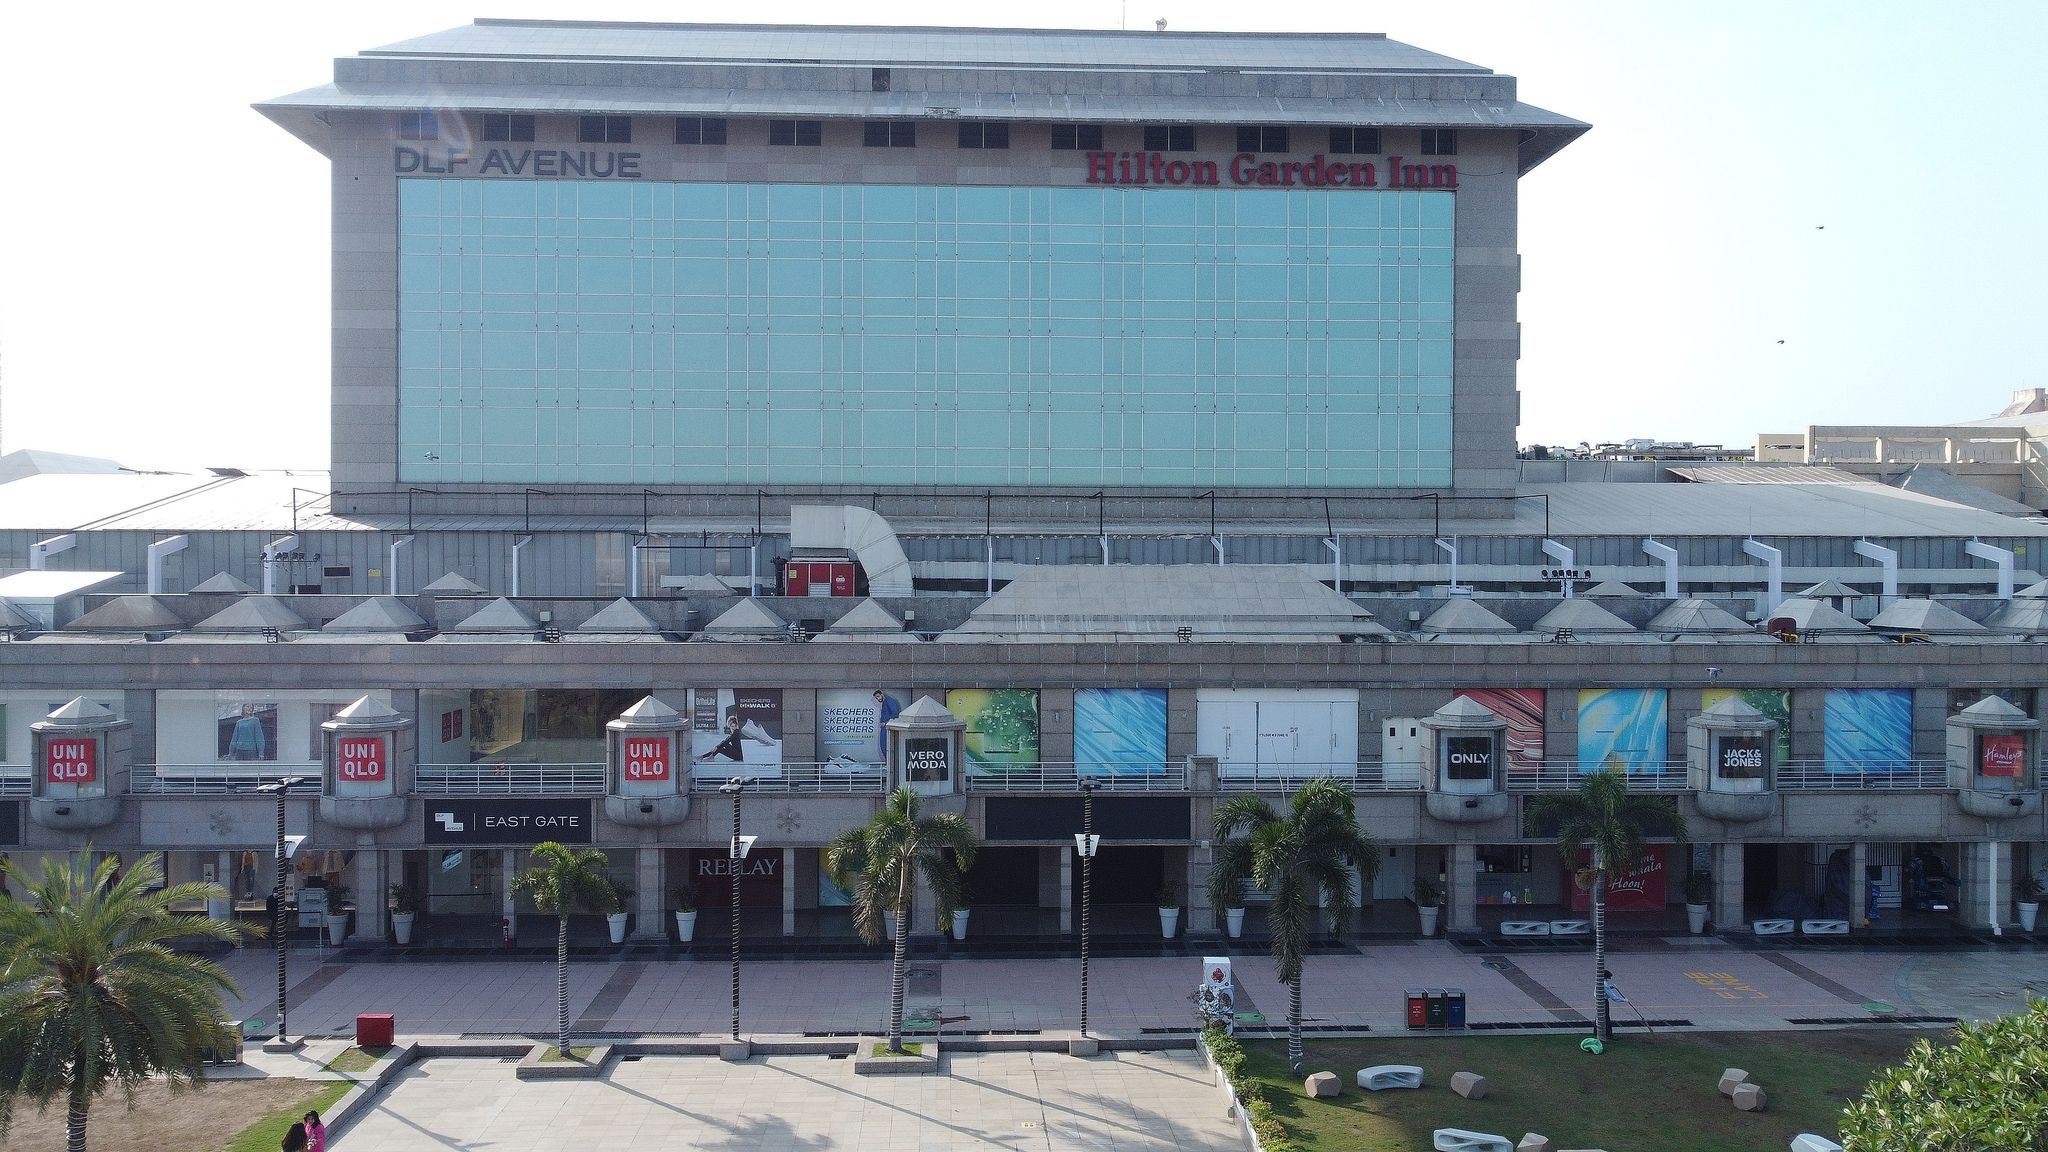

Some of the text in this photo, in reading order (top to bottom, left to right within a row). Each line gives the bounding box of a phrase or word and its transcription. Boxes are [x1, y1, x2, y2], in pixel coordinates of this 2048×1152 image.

[395, 147, 641, 177] DLF AVENUE
[1086, 151, 1459, 189] Hilton Garden Inn
[824, 708, 875, 716] SKECHERS
[824, 717, 875, 725] SKECHERS
[824, 725, 875, 733] SKECHERS
[53, 745, 84, 759] UNI
[345, 744, 375, 758] UNI
[630, 743, 660, 758] UNI
[909, 751, 944, 760] VERO
[1724, 749, 1761, 758] JACK&
[1451, 753, 1491, 763] ONLY
[1724, 758, 1761, 767] JONES
[345, 761, 378, 778] QLO
[630, 761, 664, 777] QLO
[907, 760, 946, 769] MODA
[53, 762, 88, 779] QLO
[486, 816, 579, 827] EAST GATE
